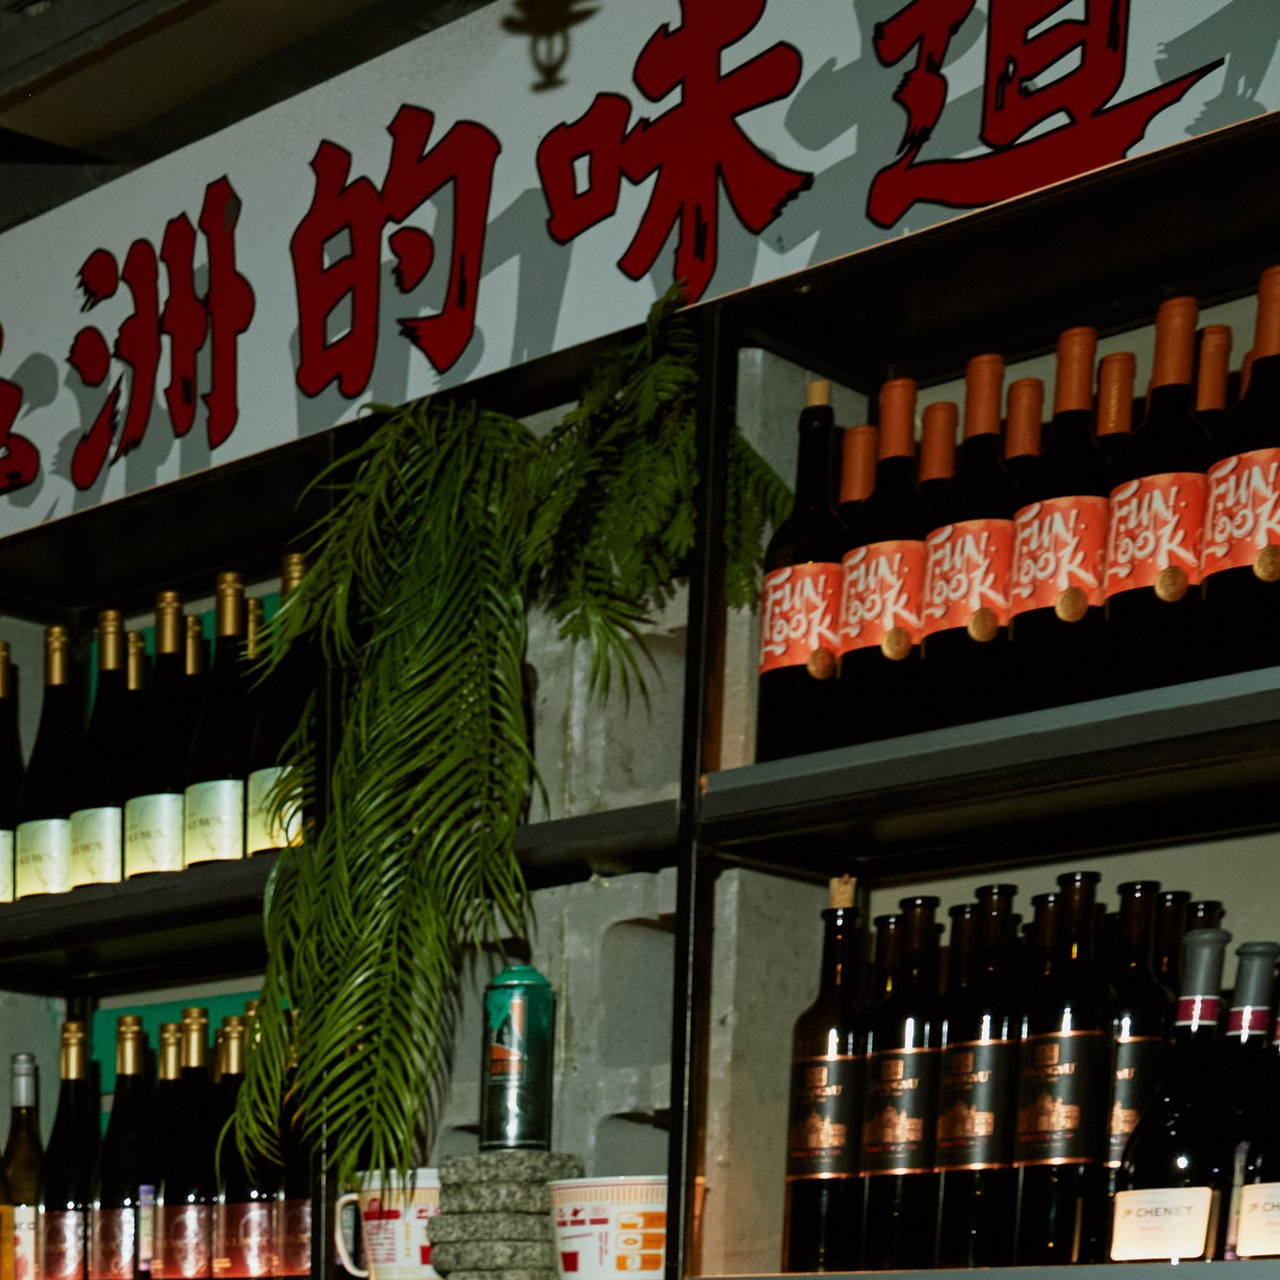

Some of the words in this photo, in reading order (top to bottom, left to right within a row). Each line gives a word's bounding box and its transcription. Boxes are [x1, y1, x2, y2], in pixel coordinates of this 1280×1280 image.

[1111, 480, 1179, 531] FUN
[1211, 457, 1279, 507] FUN
[929, 525, 989, 574] FUN
[1017, 502, 1079, 552] FUN
[766, 567, 827, 612] FUN
[845, 548, 902, 594] FUN
[1136, 1206, 1192, 1218] CHENET
